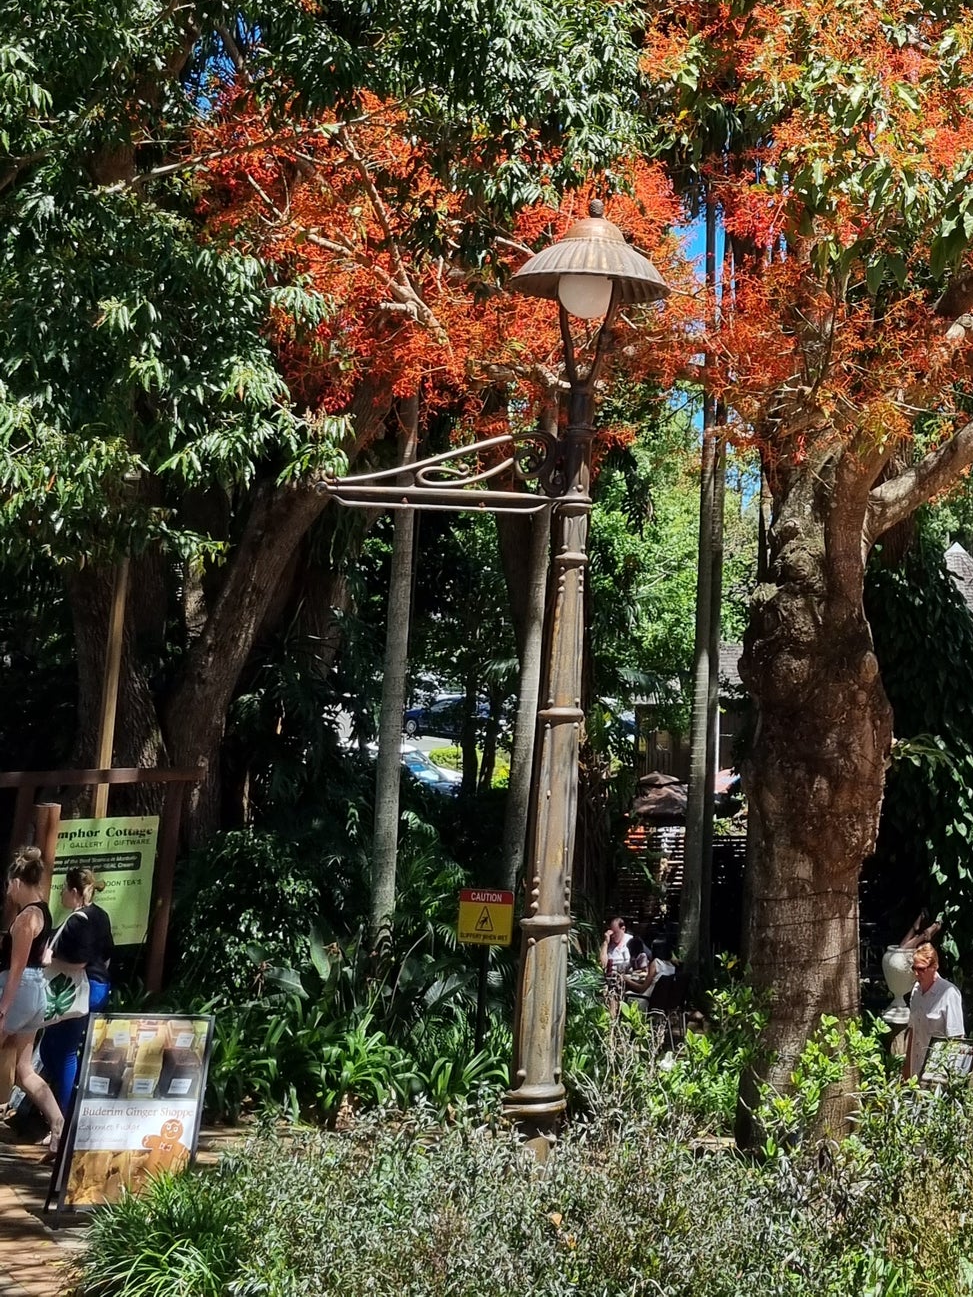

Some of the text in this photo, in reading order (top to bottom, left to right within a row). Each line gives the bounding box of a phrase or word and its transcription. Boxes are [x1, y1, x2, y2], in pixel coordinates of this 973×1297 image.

[57, 826, 154, 840] mphor Cottage
[70, 838, 152, 849] GALLERY GIFTWARE
[470, 892, 502, 902] CAUTION
[82, 1107, 194, 1118] Buderim Ginger Shoppe
